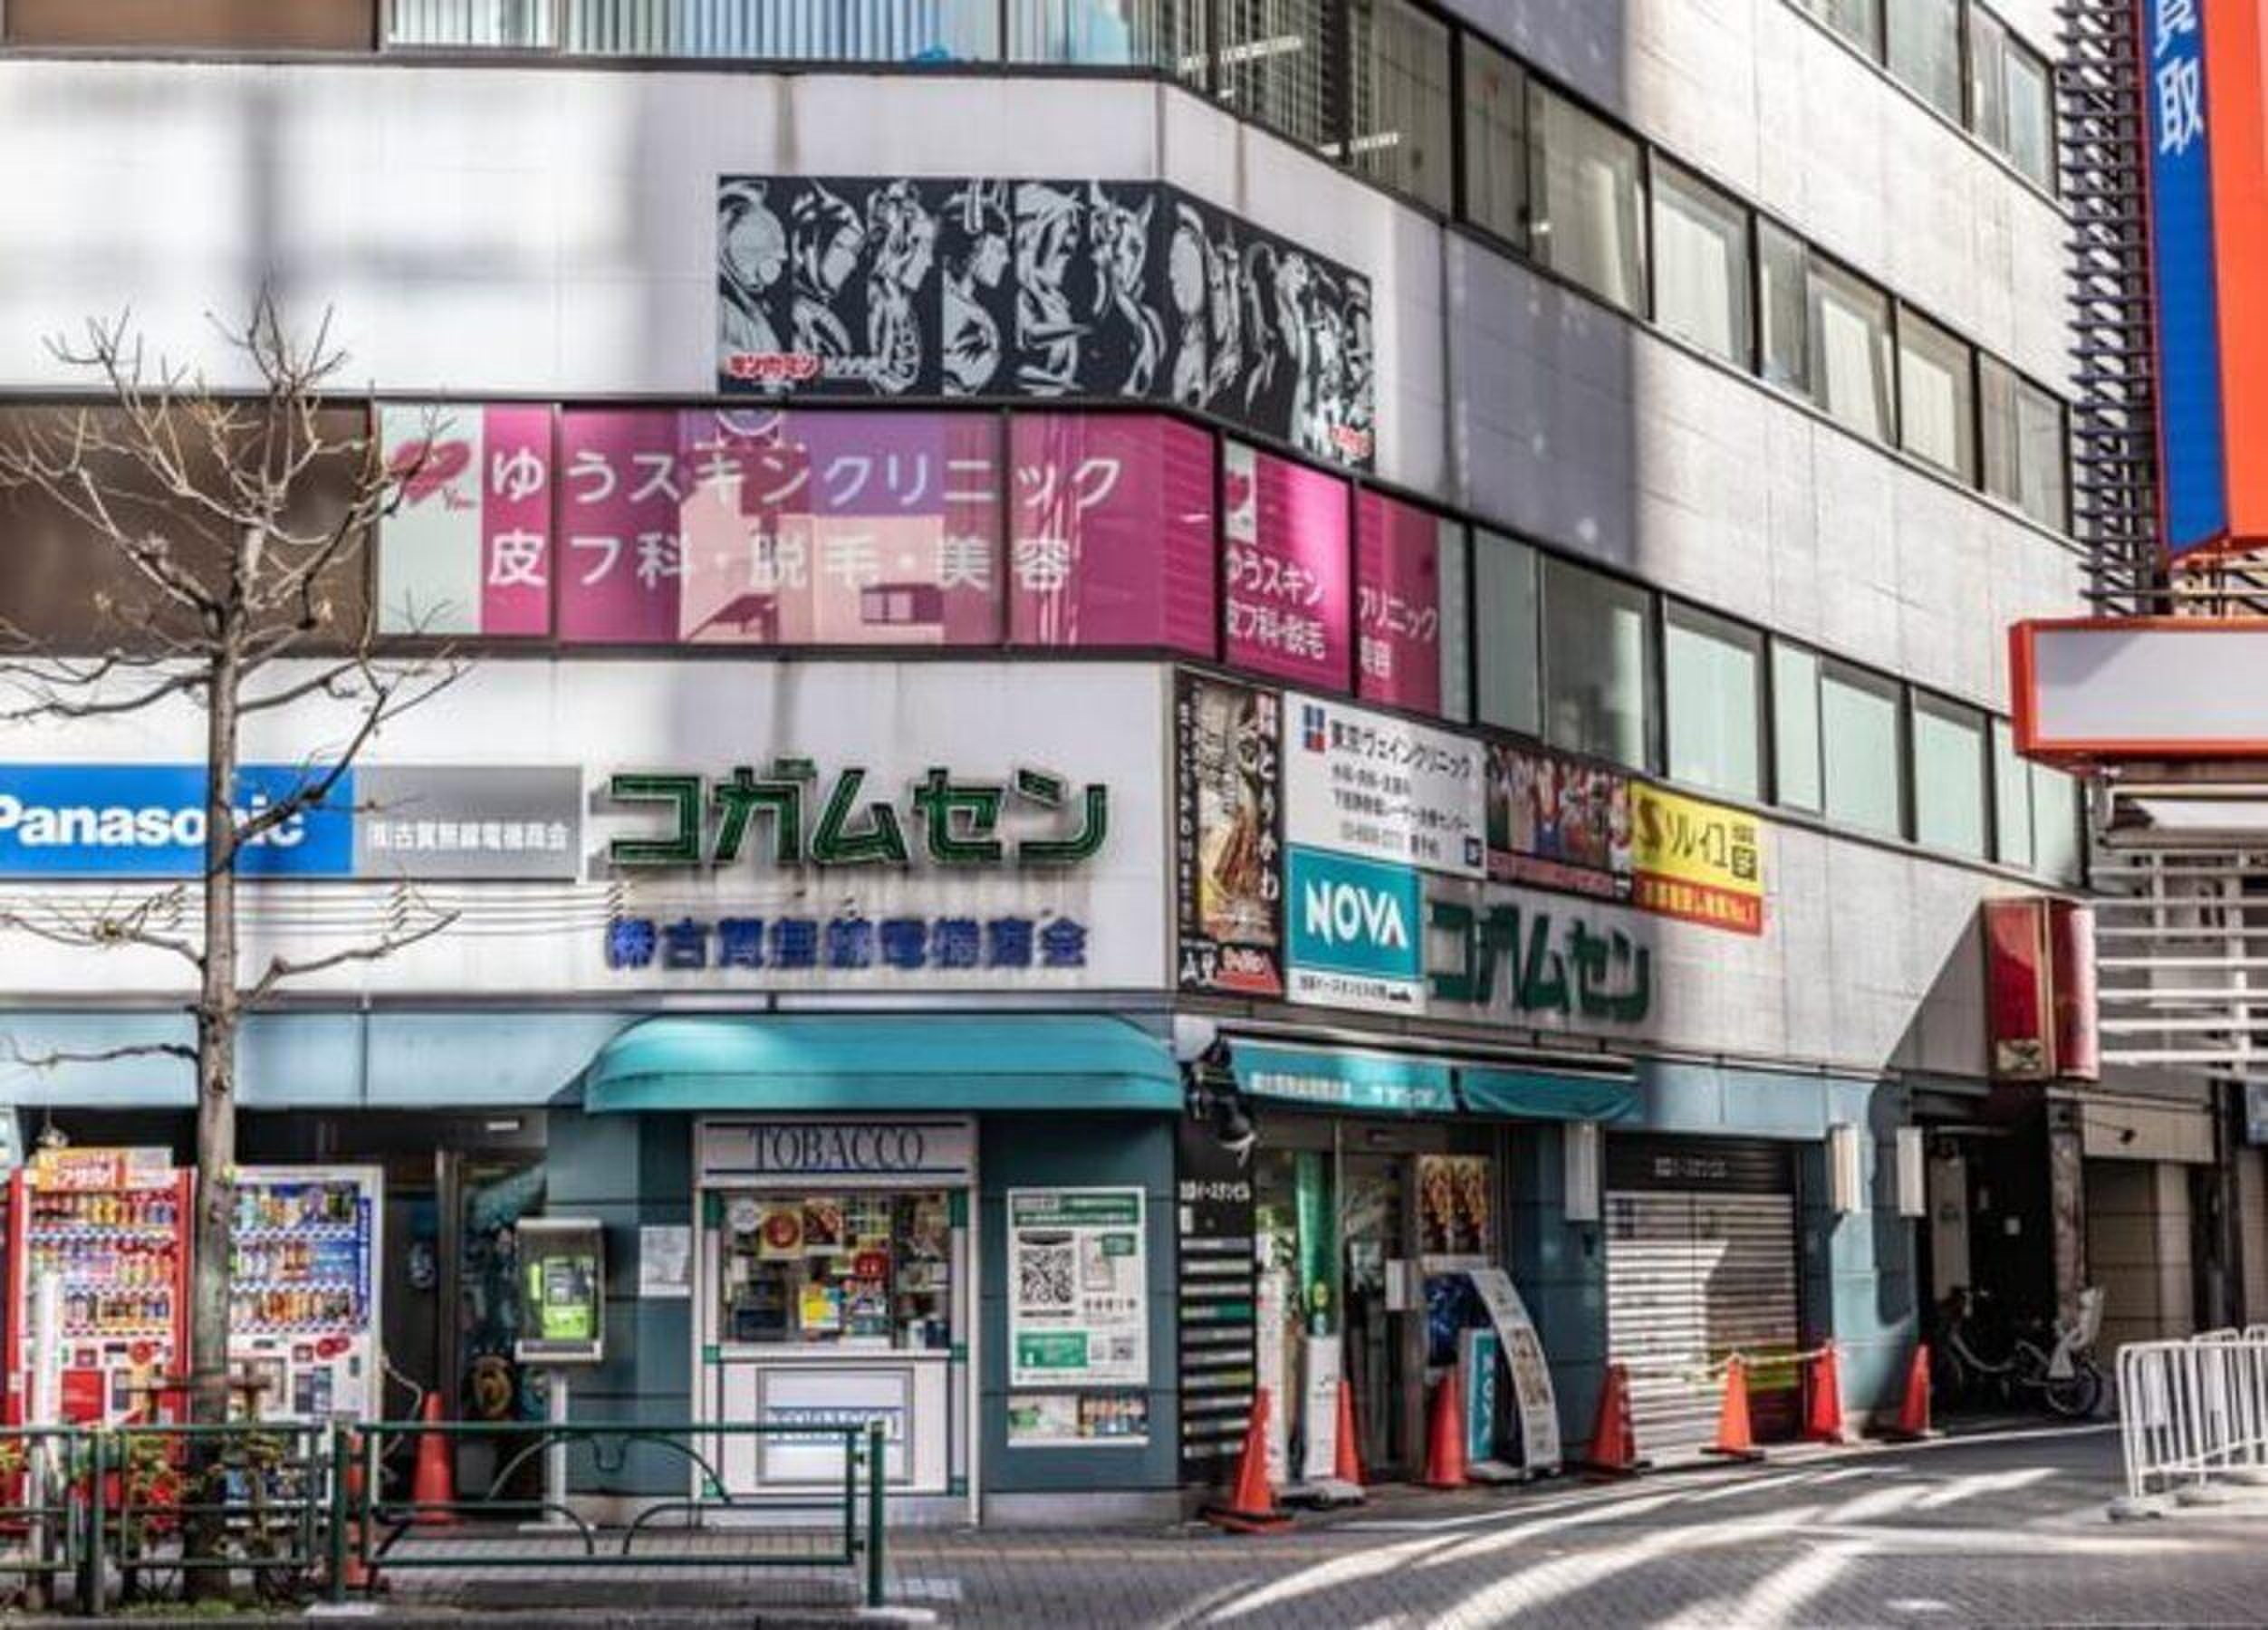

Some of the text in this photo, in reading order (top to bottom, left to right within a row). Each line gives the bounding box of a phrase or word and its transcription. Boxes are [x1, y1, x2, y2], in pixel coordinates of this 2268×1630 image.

[493, 446, 1120, 508] ゆうスキンクリニック
[609, 758, 1109, 867] コガムセン
[1305, 878, 1408, 950] NOVA
[746, 1127, 925, 1170] TOBACCO
